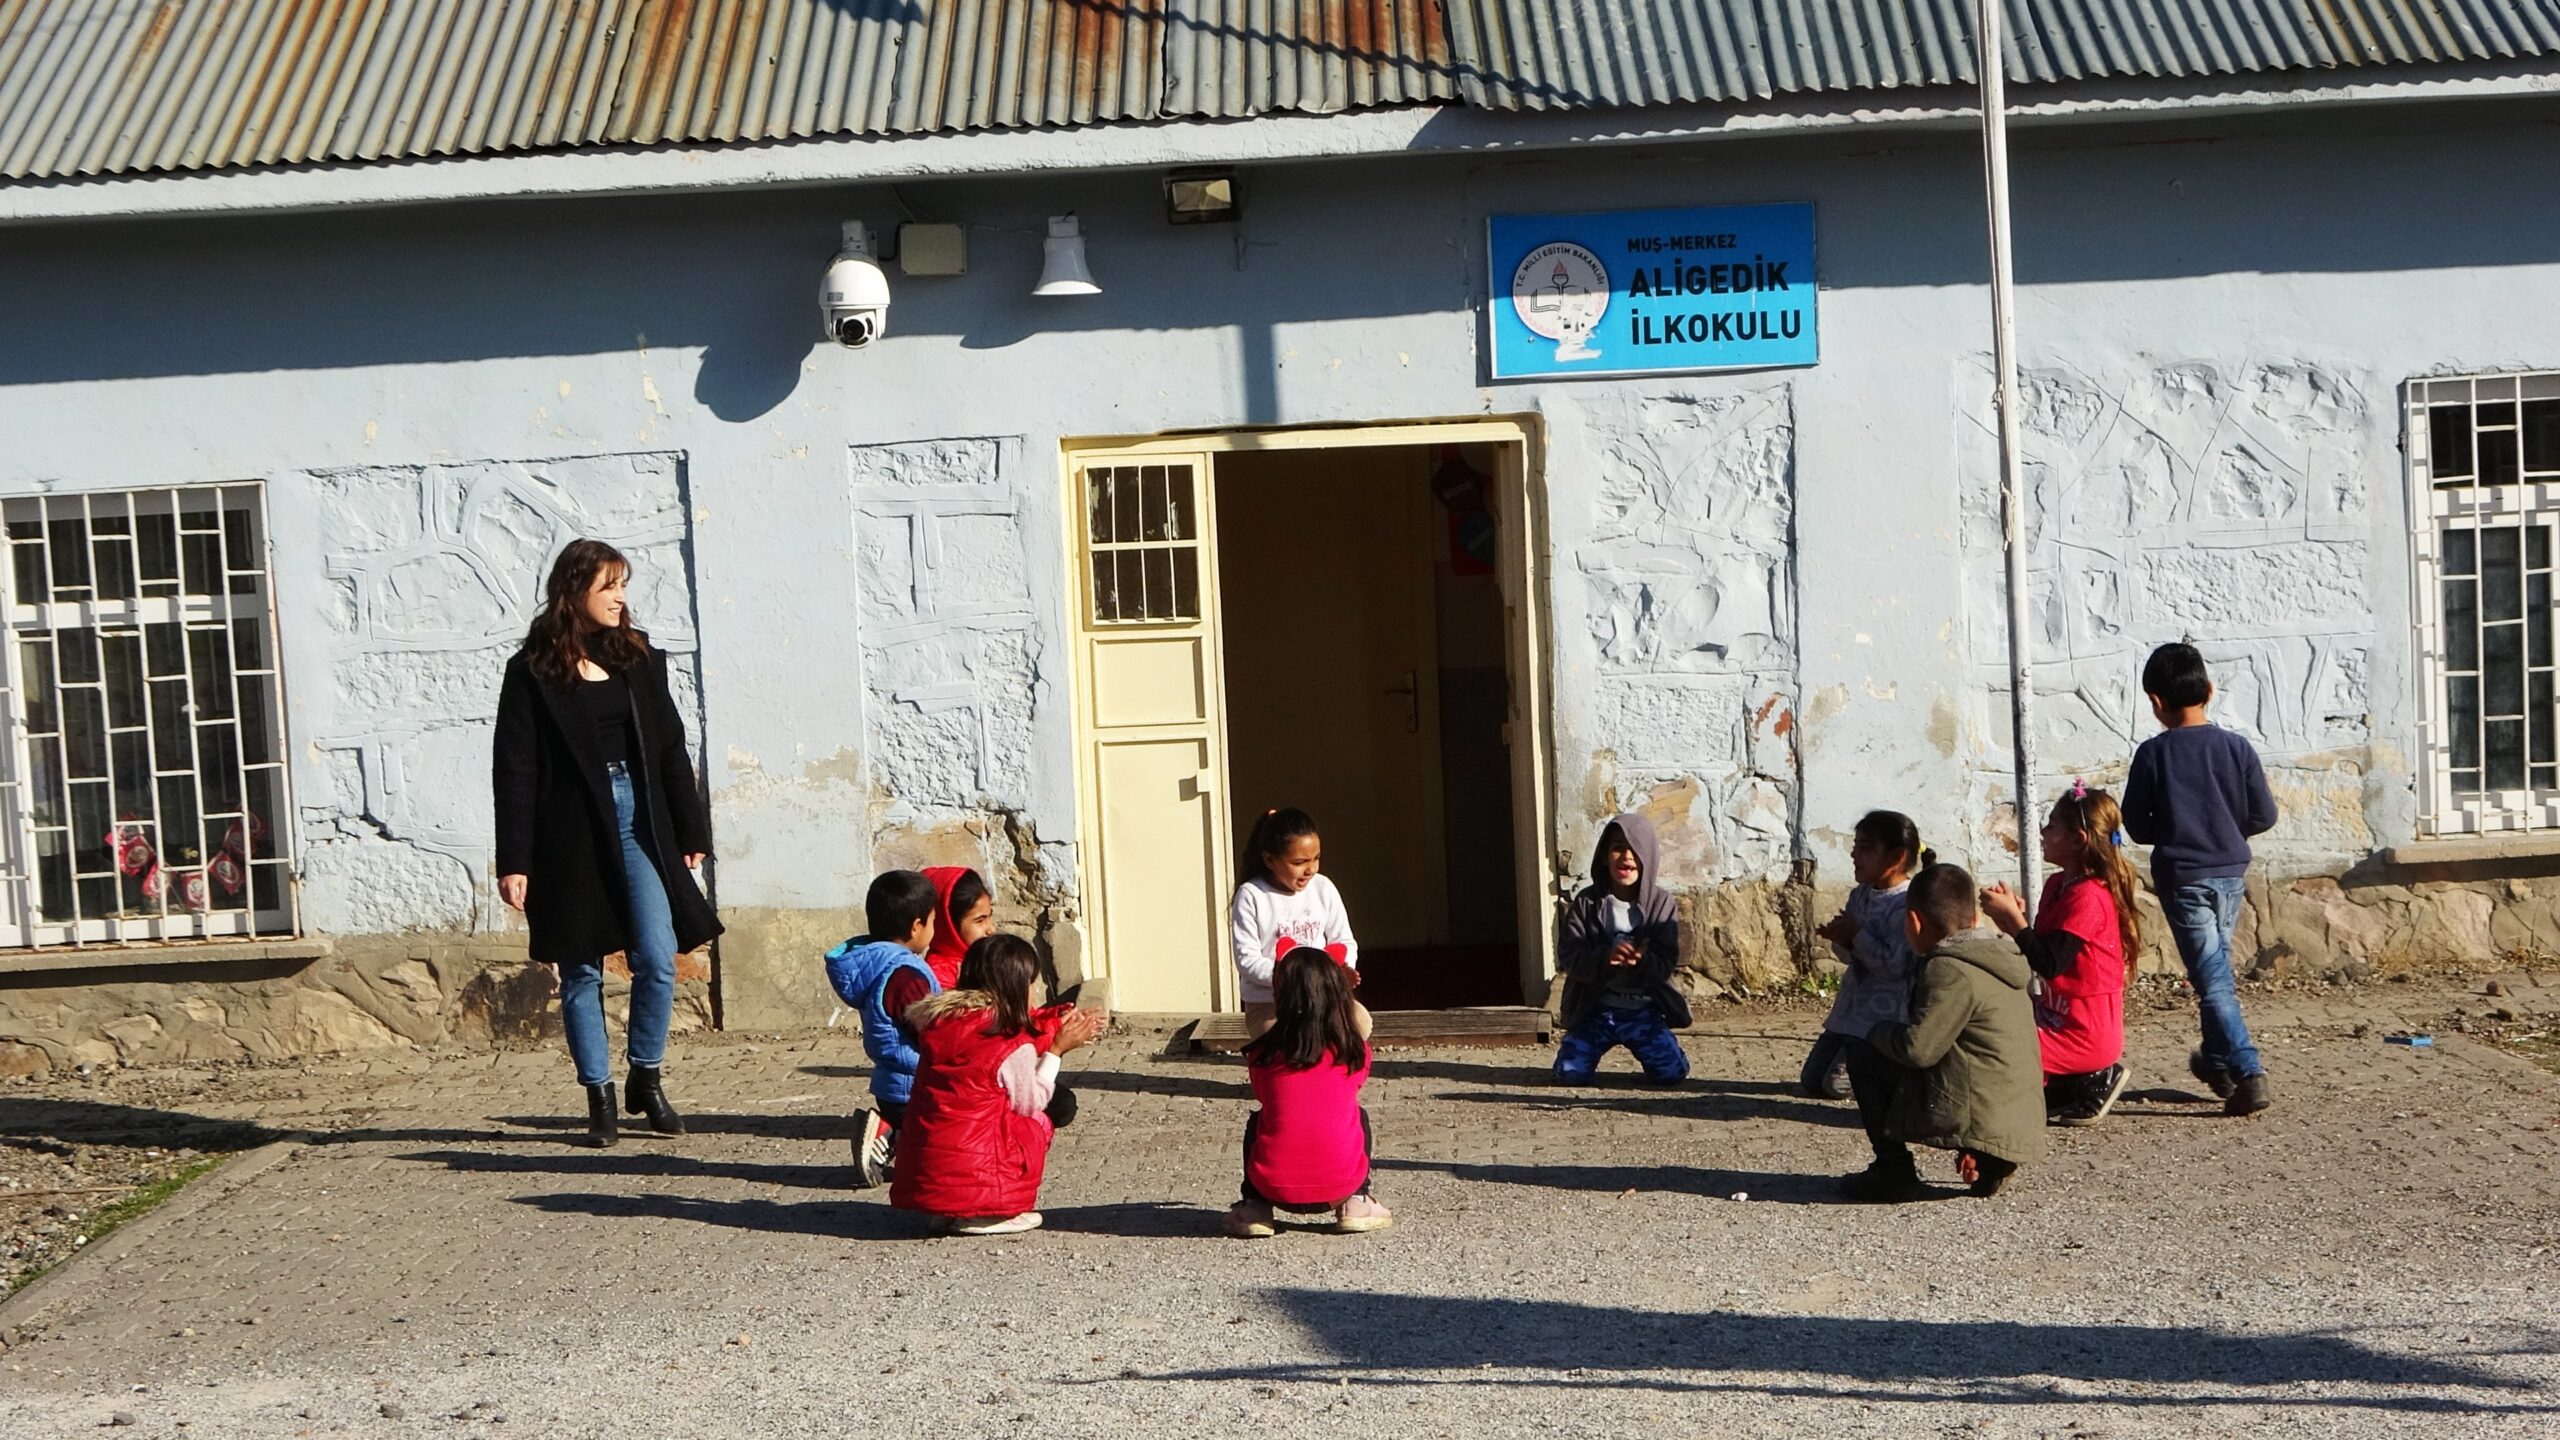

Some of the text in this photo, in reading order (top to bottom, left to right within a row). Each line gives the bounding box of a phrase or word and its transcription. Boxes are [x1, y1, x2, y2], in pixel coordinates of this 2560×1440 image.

[1628, 234, 1736, 253] MUŞ-MERKEZ
[1543, 246, 1571, 257] EĞİTİM
[1572, 250, 1604, 285] BAKANLIĞI
[1629, 254, 1789, 298] ALİGEDİK
[1632, 308, 1800, 345] İLKOKULU
